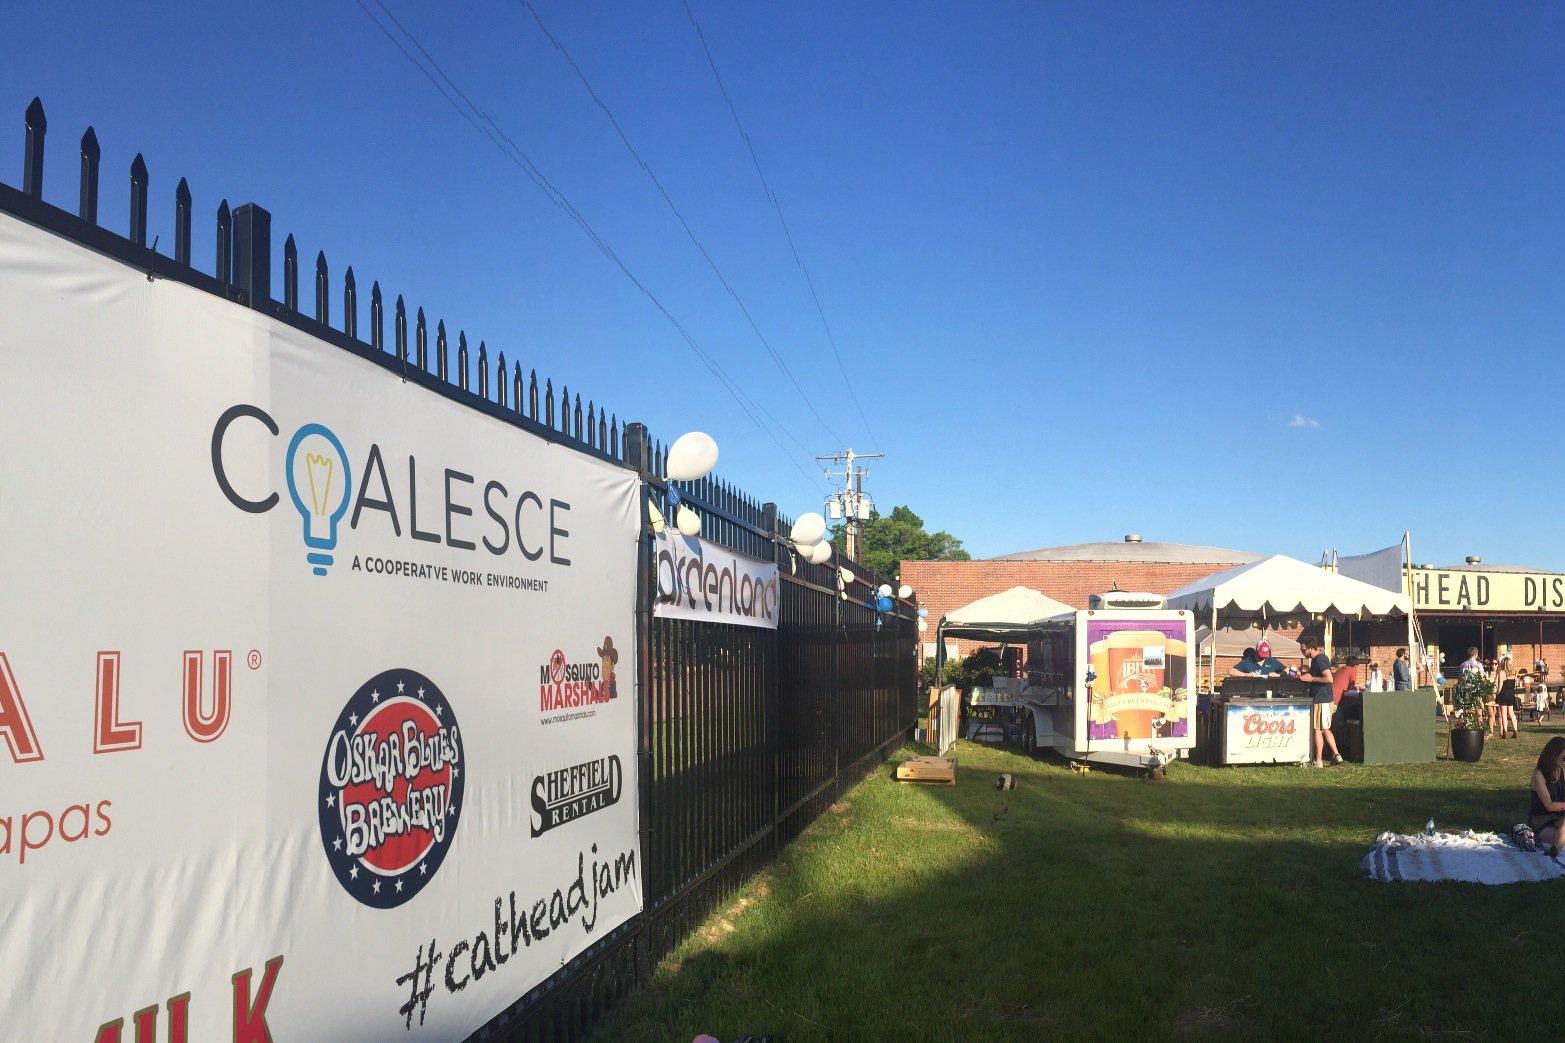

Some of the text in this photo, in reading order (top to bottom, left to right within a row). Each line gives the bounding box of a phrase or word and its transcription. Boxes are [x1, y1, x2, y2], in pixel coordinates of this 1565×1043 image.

[351, 555, 362, 571] A
[451, 569, 483, 586] WORK
[487, 573, 548, 592] ENVIRONMENT
[1402, 571, 1490, 606] HEAD
[540, 680, 610, 712] MARSHALS
[1243, 712, 1296, 735] Coors
[531, 754, 622, 840] SHEFFIELD
[552, 793, 606, 826] RENTAL
[396, 842, 636, 1031] #catheadjam
